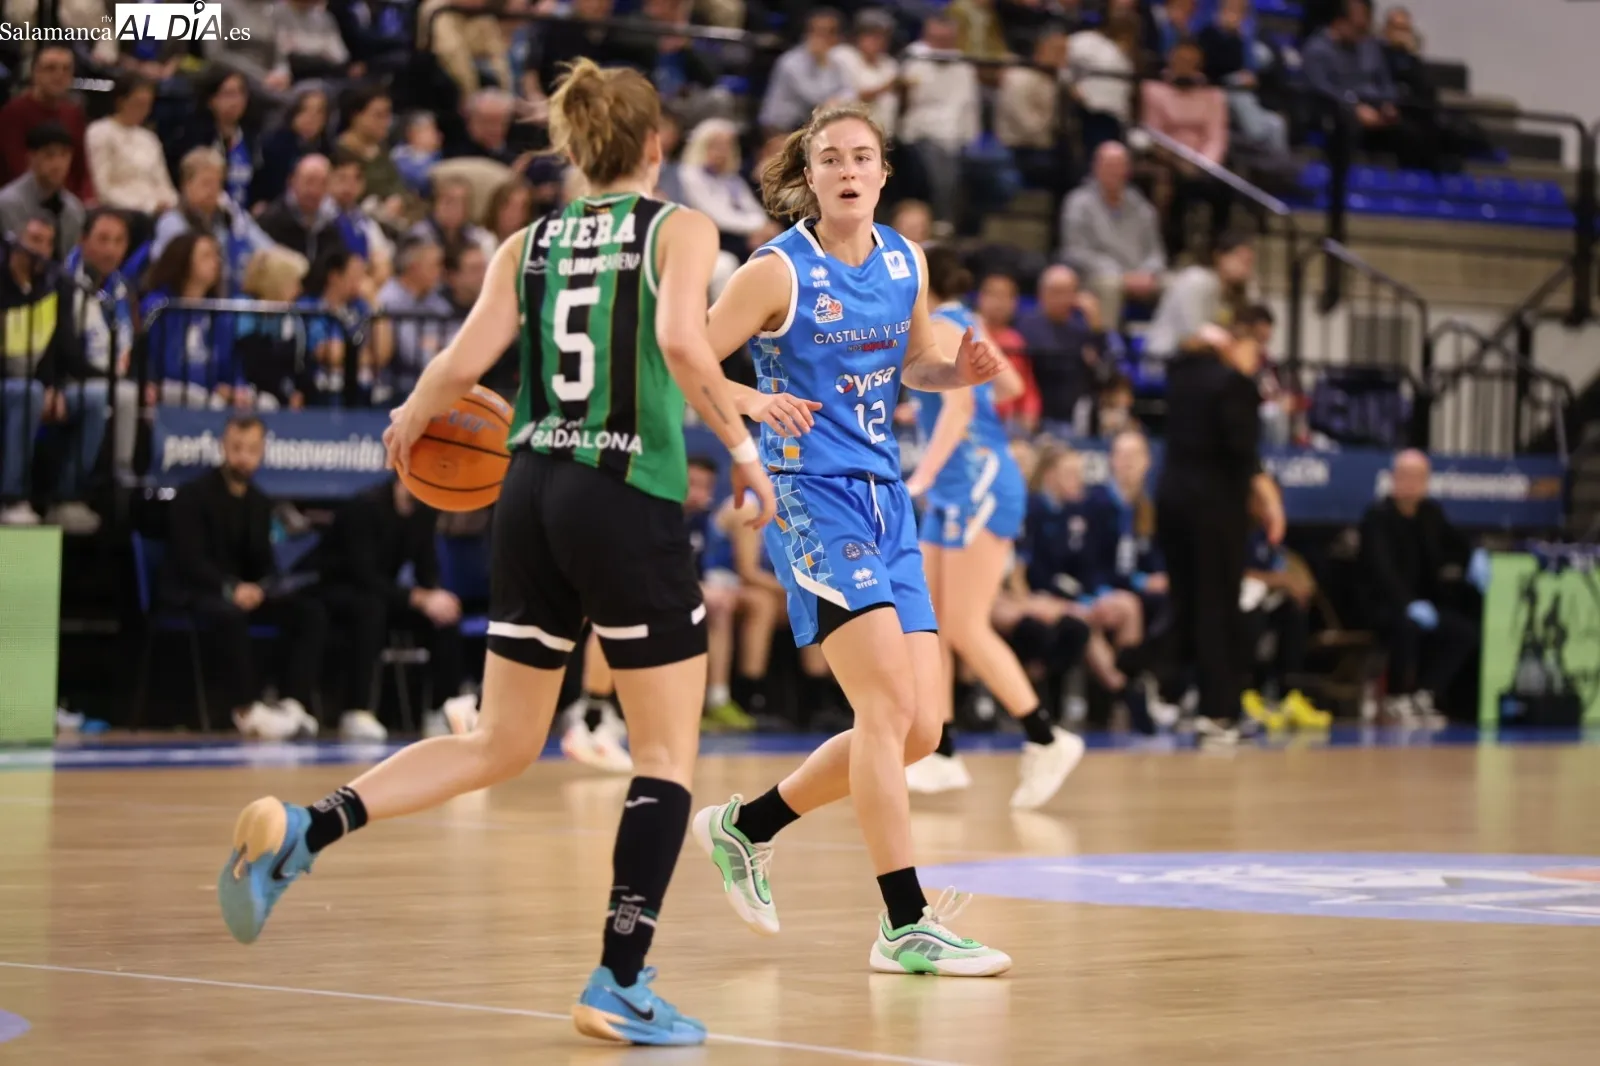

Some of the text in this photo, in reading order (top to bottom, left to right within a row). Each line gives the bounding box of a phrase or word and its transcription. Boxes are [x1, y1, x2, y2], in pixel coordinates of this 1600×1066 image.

[552, 286, 600, 402] 5
[813, 326, 878, 344] CASTILLA
[882, 323, 891, 339] Y
[853, 399, 887, 445] 12
[530, 427, 643, 456] BADALONA
